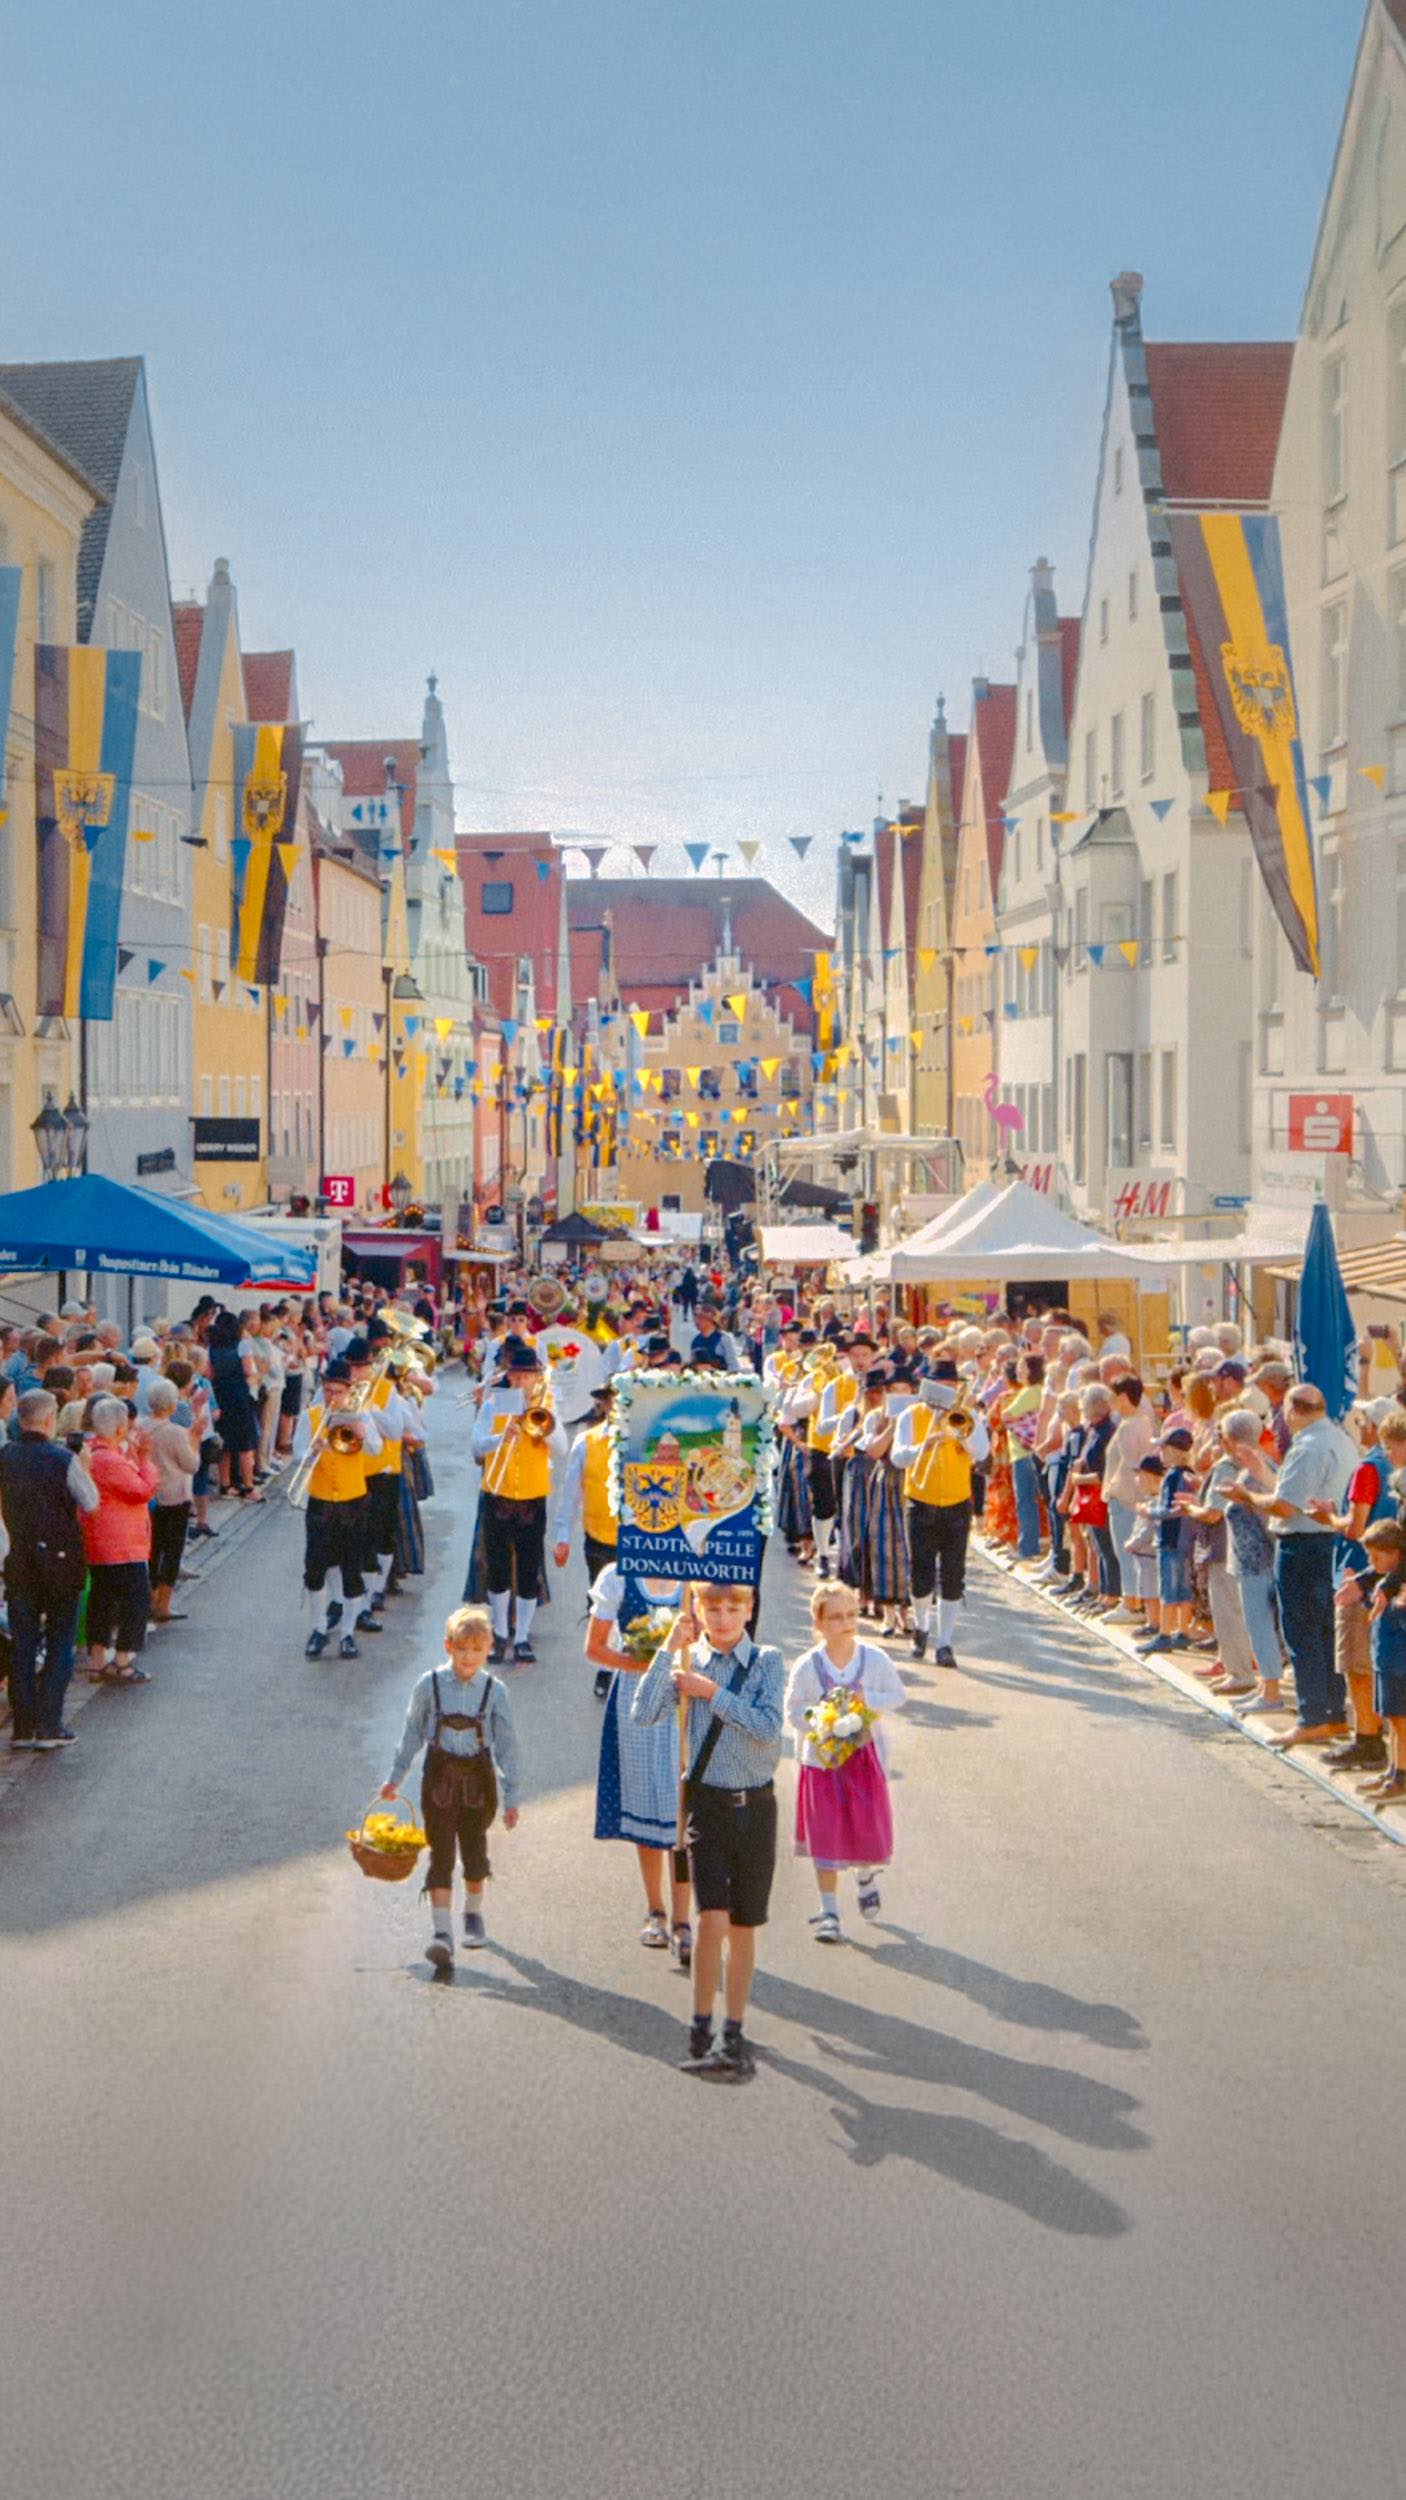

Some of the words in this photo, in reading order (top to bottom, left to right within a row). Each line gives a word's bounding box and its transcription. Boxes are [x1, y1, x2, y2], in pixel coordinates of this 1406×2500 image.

[329, 1180, 349, 1203] T
[1111, 1180, 1171, 1218] H&M
[622, 1535, 755, 1557] STADTKPELLE
[621, 1557, 755, 1580] DONAUWÖRTH
